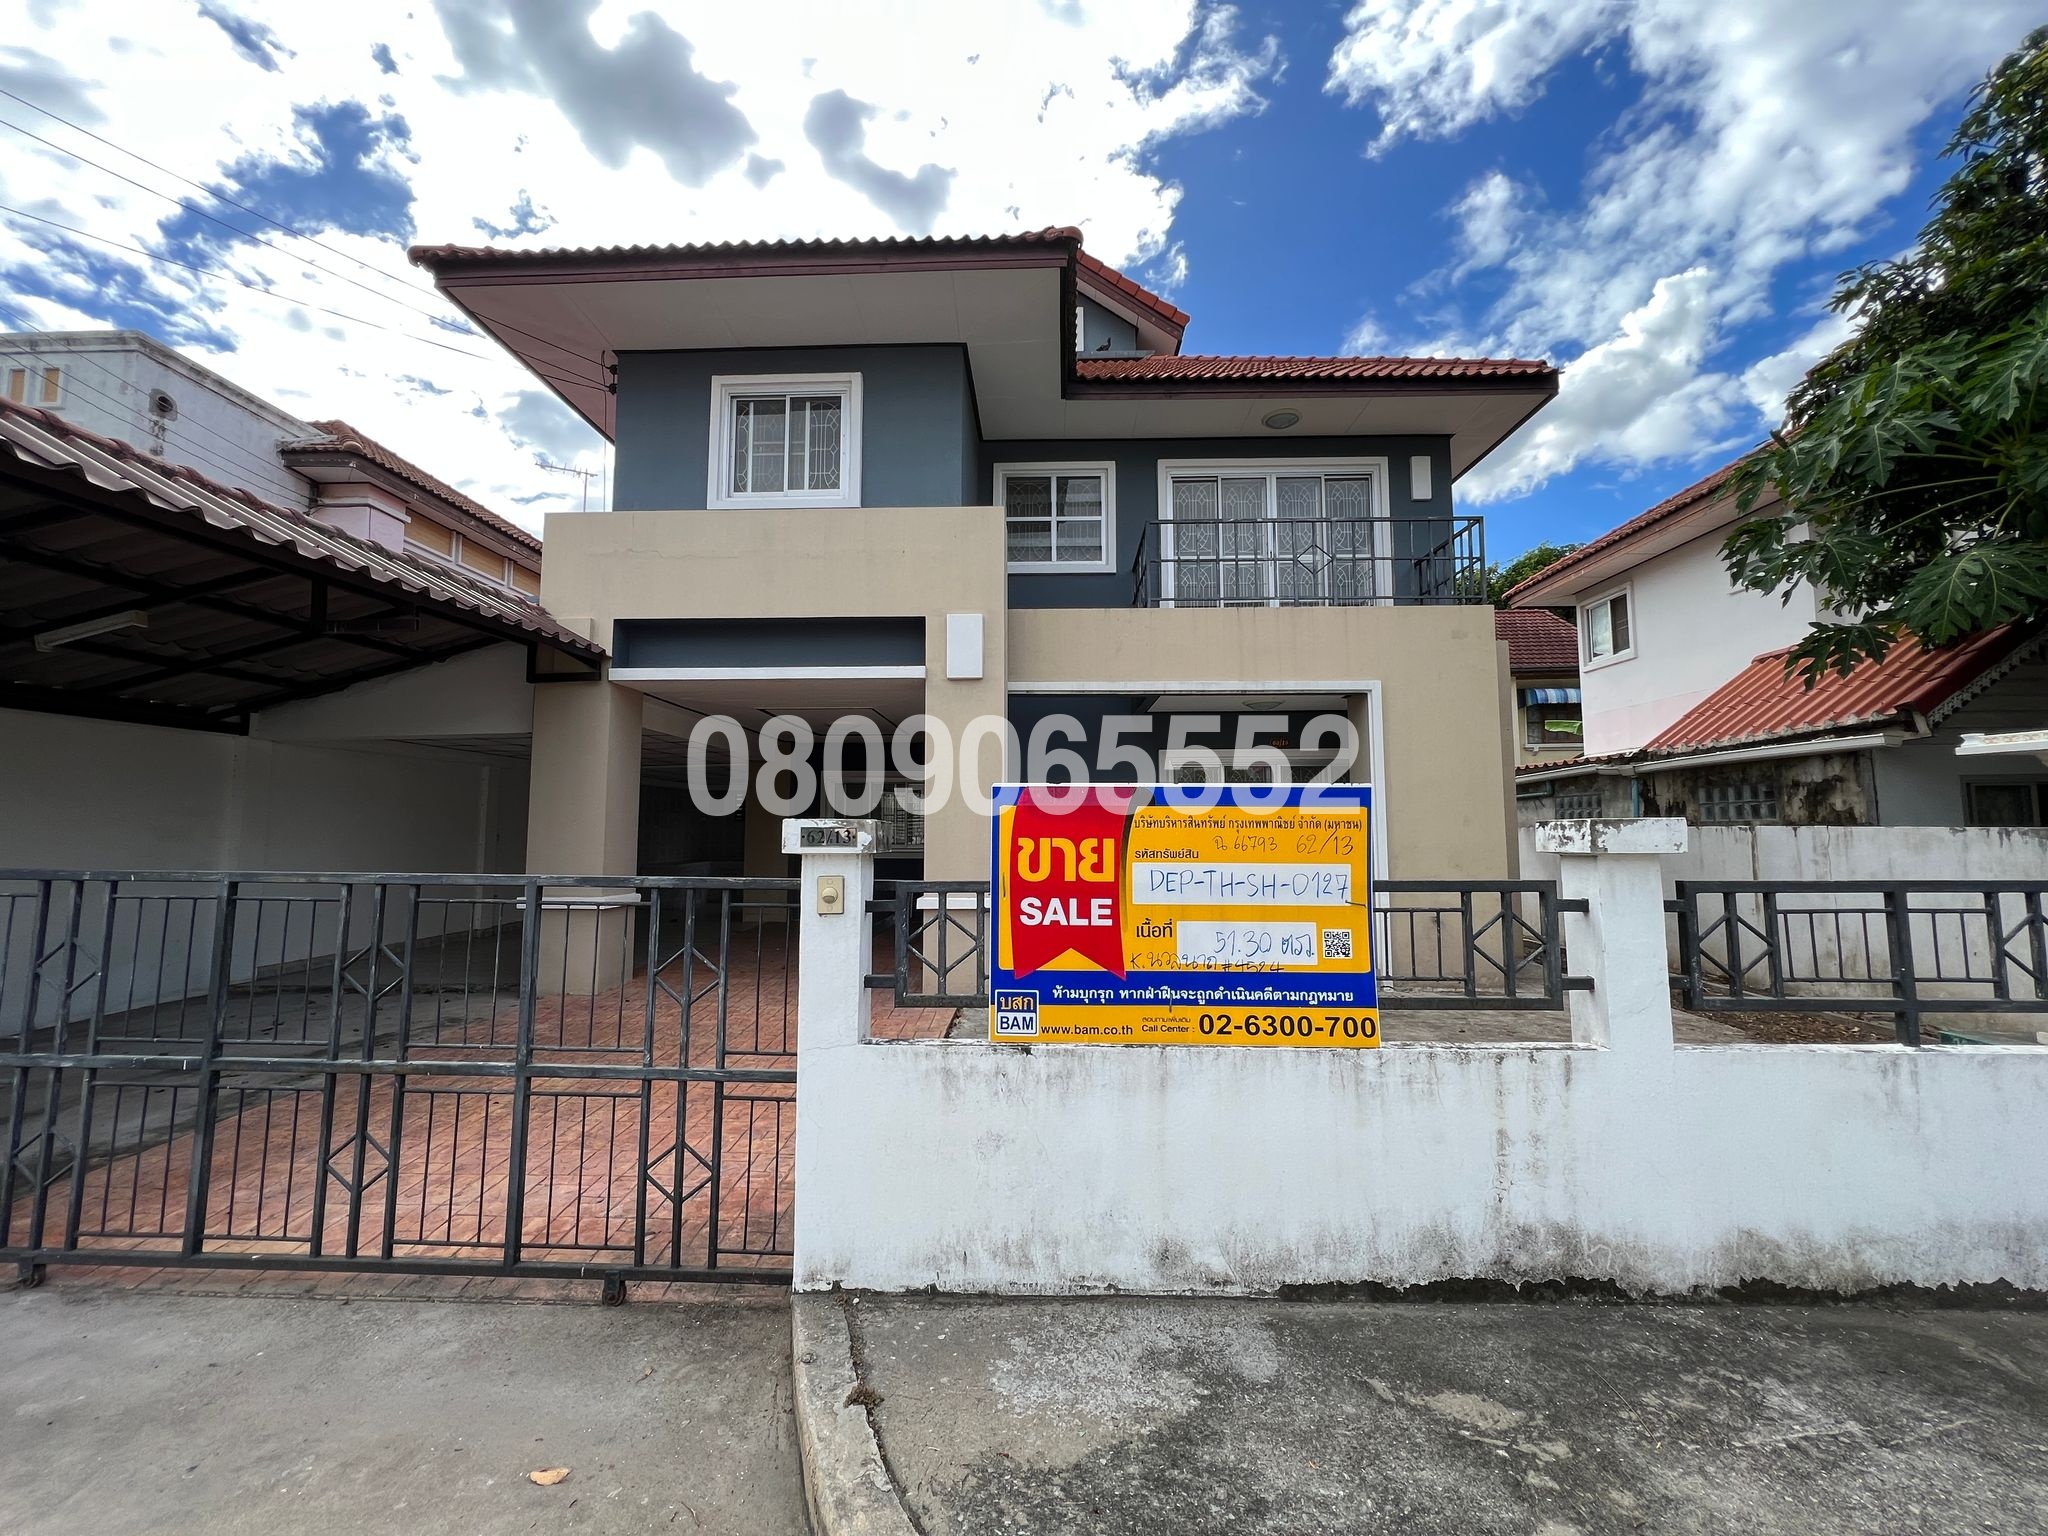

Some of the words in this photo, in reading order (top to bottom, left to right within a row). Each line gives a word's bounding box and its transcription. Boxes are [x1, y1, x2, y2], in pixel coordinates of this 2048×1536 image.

[1134, 814, 1226, 829] บริษัทบริหารสินทรัพย์
[1229, 815, 1296, 834] กรุงเทพพาณิชย์
[1298, 815, 1322, 829] จำกัด
[1324, 819, 1362, 832] (มหาชน)
[806, 829, 852, 845] 62/13
[1233, 834, 1278, 853] 66793
[1296, 829, 1354, 856] 62/13
[1017, 837, 1115, 882] ขาย
[1134, 848, 1199, 859] รหัสทรัพย์สิน
[1149, 869, 1350, 900] DEP-TH-SH-0127
[1019, 896, 1113, 926] SALE
[1135, 917, 1173, 938] เนื้อที่
[1213, 929, 1272, 957] 51.30
[999, 995, 1034, 1011] บสก
[1052, 984, 1114, 1004] ห้ามบุกรุก
[1119, 985, 1354, 1005] หากฝ่าฝืนจะถูกดำเนินคดีตามกฎหมาย
[999, 1016, 1034, 1031] BAM
[1041, 1024, 1133, 1035] www.bam.co.th
[1141, 1024, 1158, 1032] Call
[1160, 1024, 1190, 1033] Center
[1199, 1013, 1376, 1038] 02-6300-700
